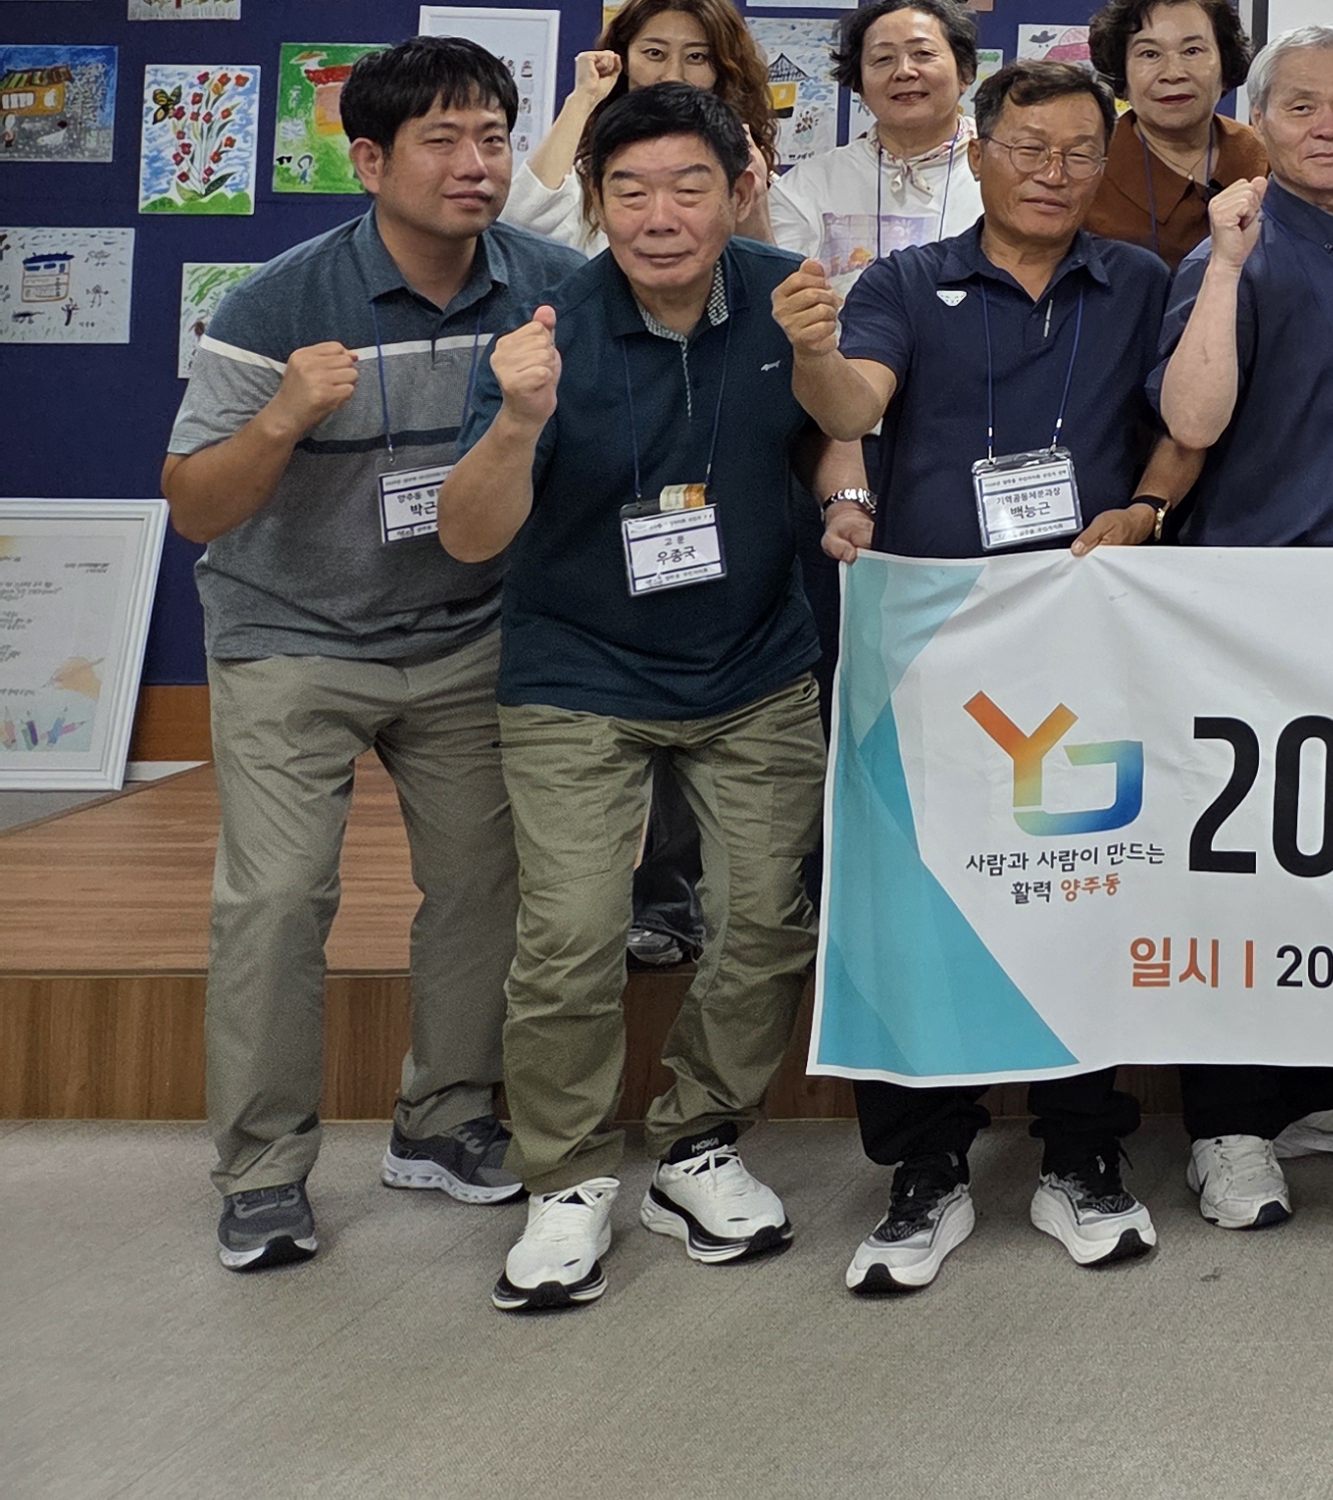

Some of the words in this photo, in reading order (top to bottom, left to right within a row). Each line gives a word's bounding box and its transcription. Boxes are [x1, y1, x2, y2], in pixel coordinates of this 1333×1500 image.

[410, 500, 438, 516] 박근
[966, 852, 1029, 877] 사람과
[1036, 847, 1099, 872] 사람이
[1107, 842, 1166, 866] 만드는
[1011, 880, 1051, 904] 활력
[1060, 872, 1121, 902] 양주동
[1130, 937, 1219, 988] 일시
